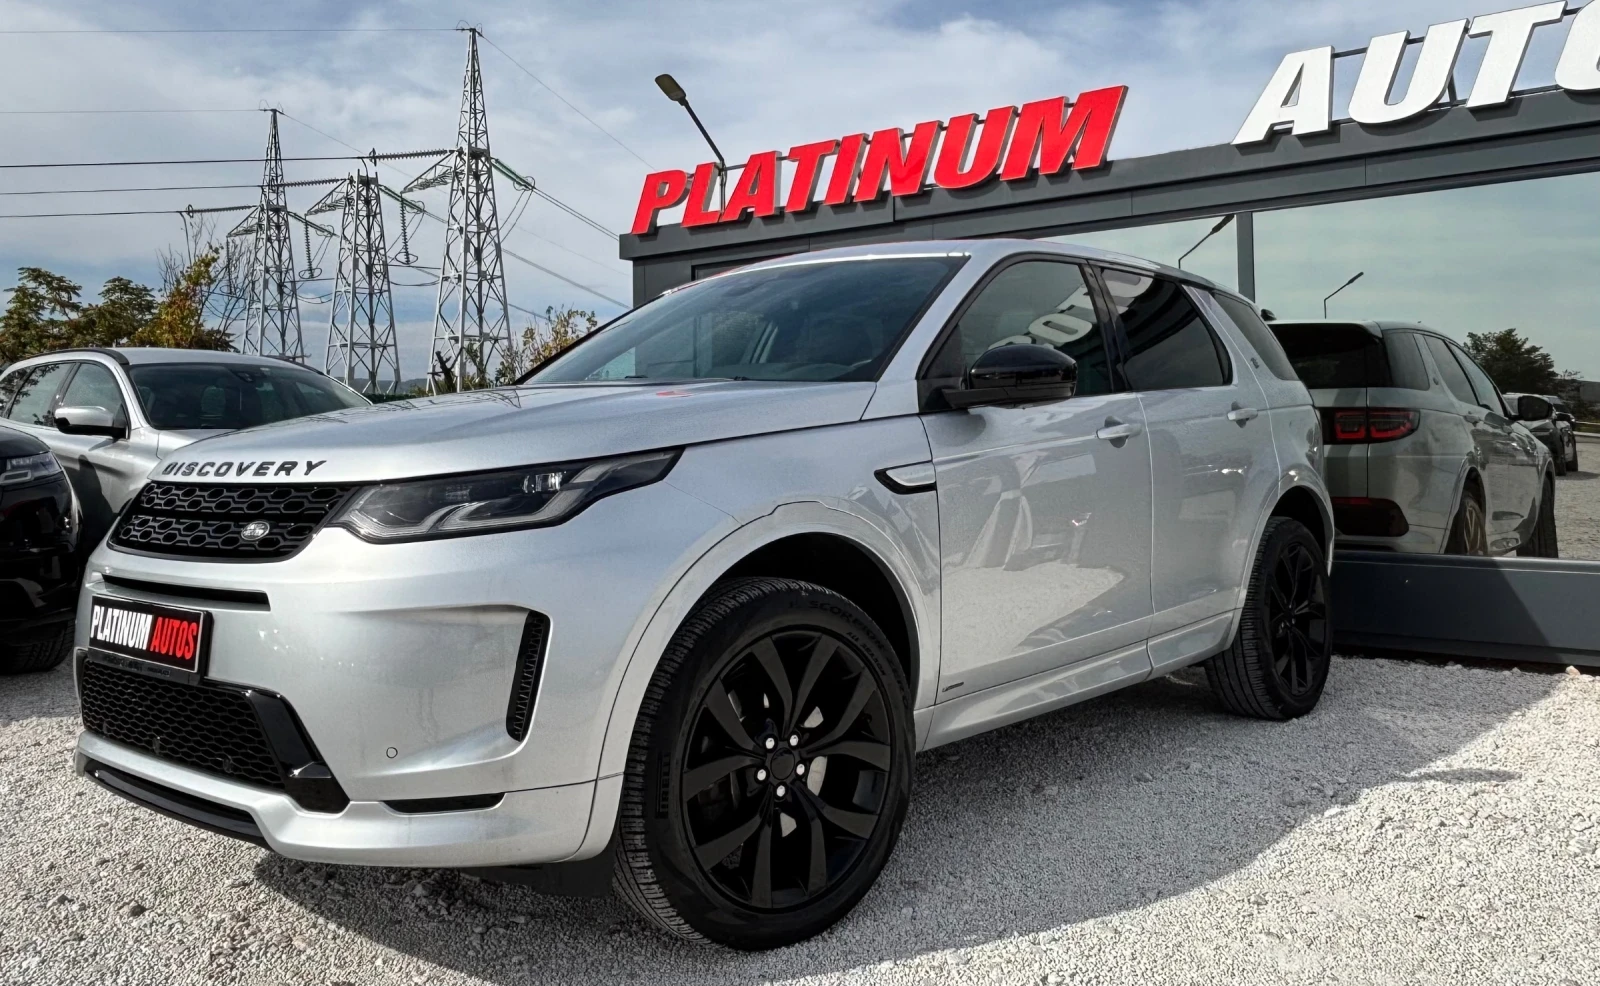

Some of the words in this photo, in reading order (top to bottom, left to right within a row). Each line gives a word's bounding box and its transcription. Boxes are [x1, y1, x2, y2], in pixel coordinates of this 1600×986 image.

[631, 85, 1128, 235] PLATINUM
[162, 460, 327, 477] DISCOVERY
[90, 604, 153, 650] PLATINUM
[149, 616, 198, 660] AUTOS
